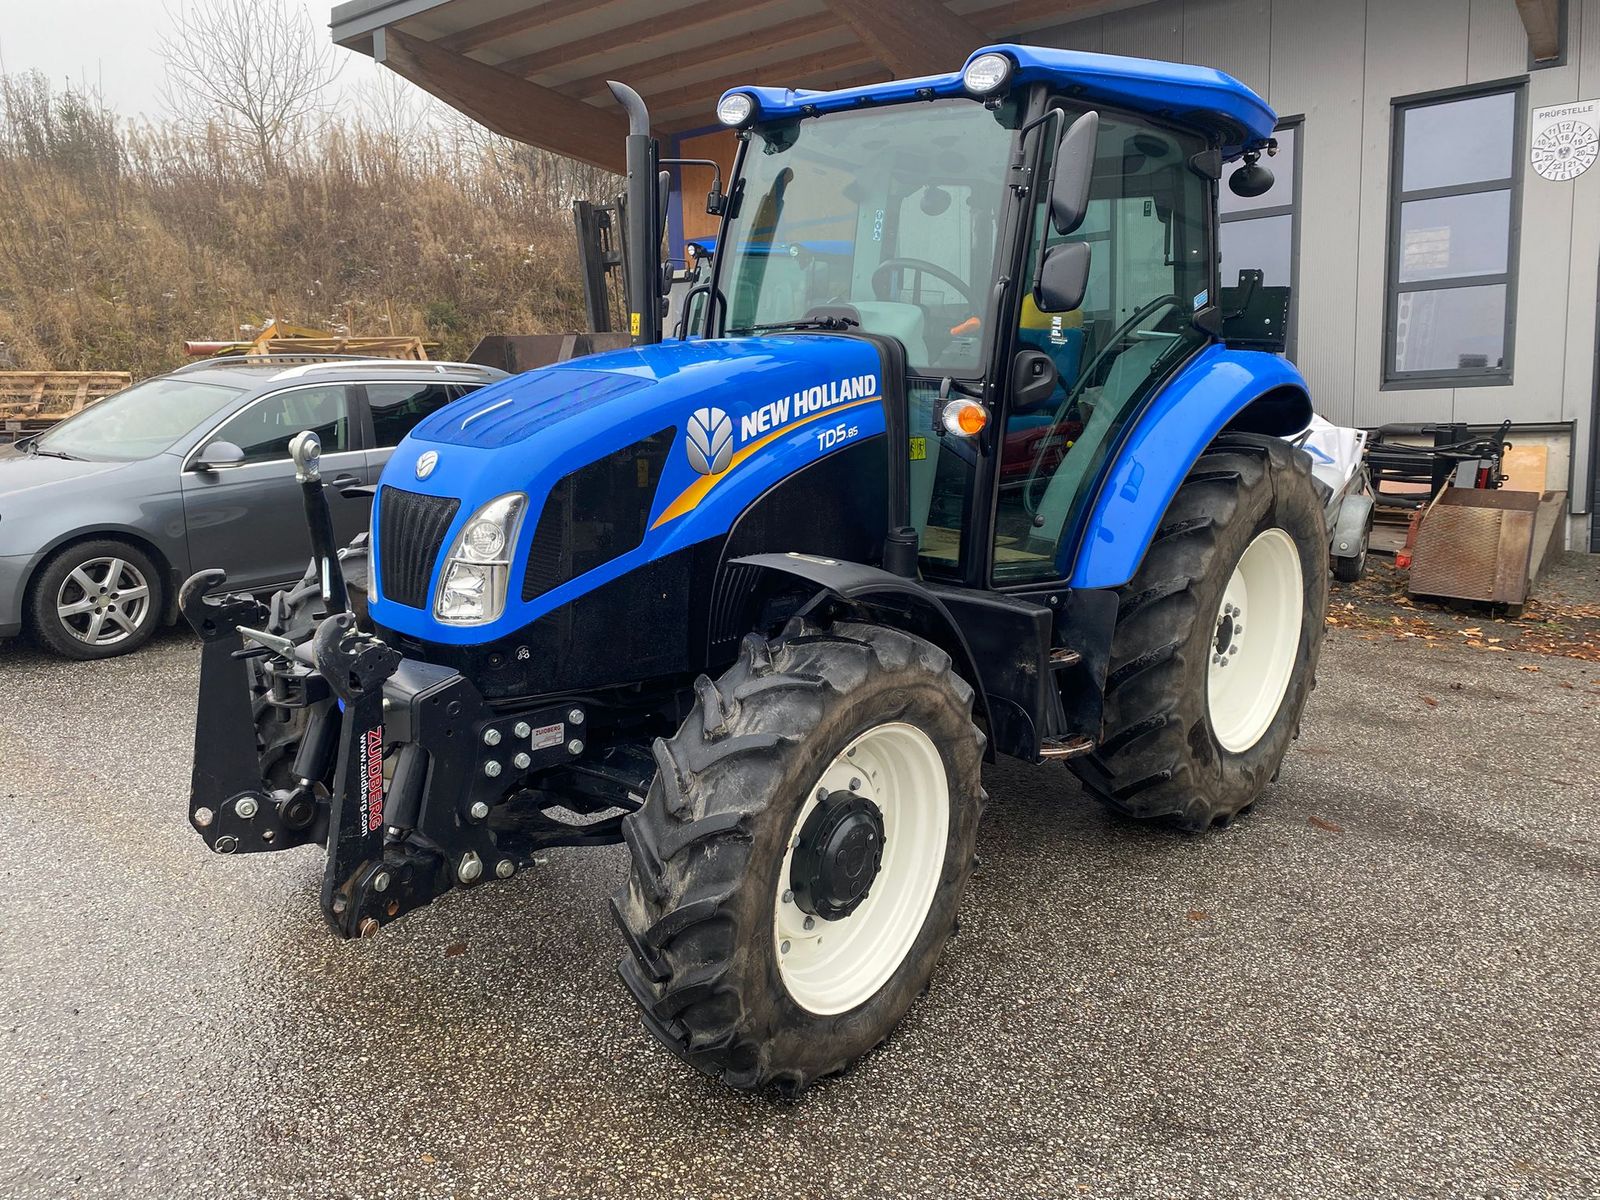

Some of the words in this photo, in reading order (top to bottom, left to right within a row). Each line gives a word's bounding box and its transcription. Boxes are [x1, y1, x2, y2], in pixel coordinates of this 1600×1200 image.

[1539, 105, 1594, 118] PRÜFSTELLE
[1052, 316, 1062, 337] PLM
[741, 397, 790, 442] NEW
[794, 374, 876, 418] HOLLAND
[817, 423, 858, 451] TD5.85
[360, 733, 368, 837] www.zuidberg.com
[367, 725, 383, 831] ZUIDBERG
